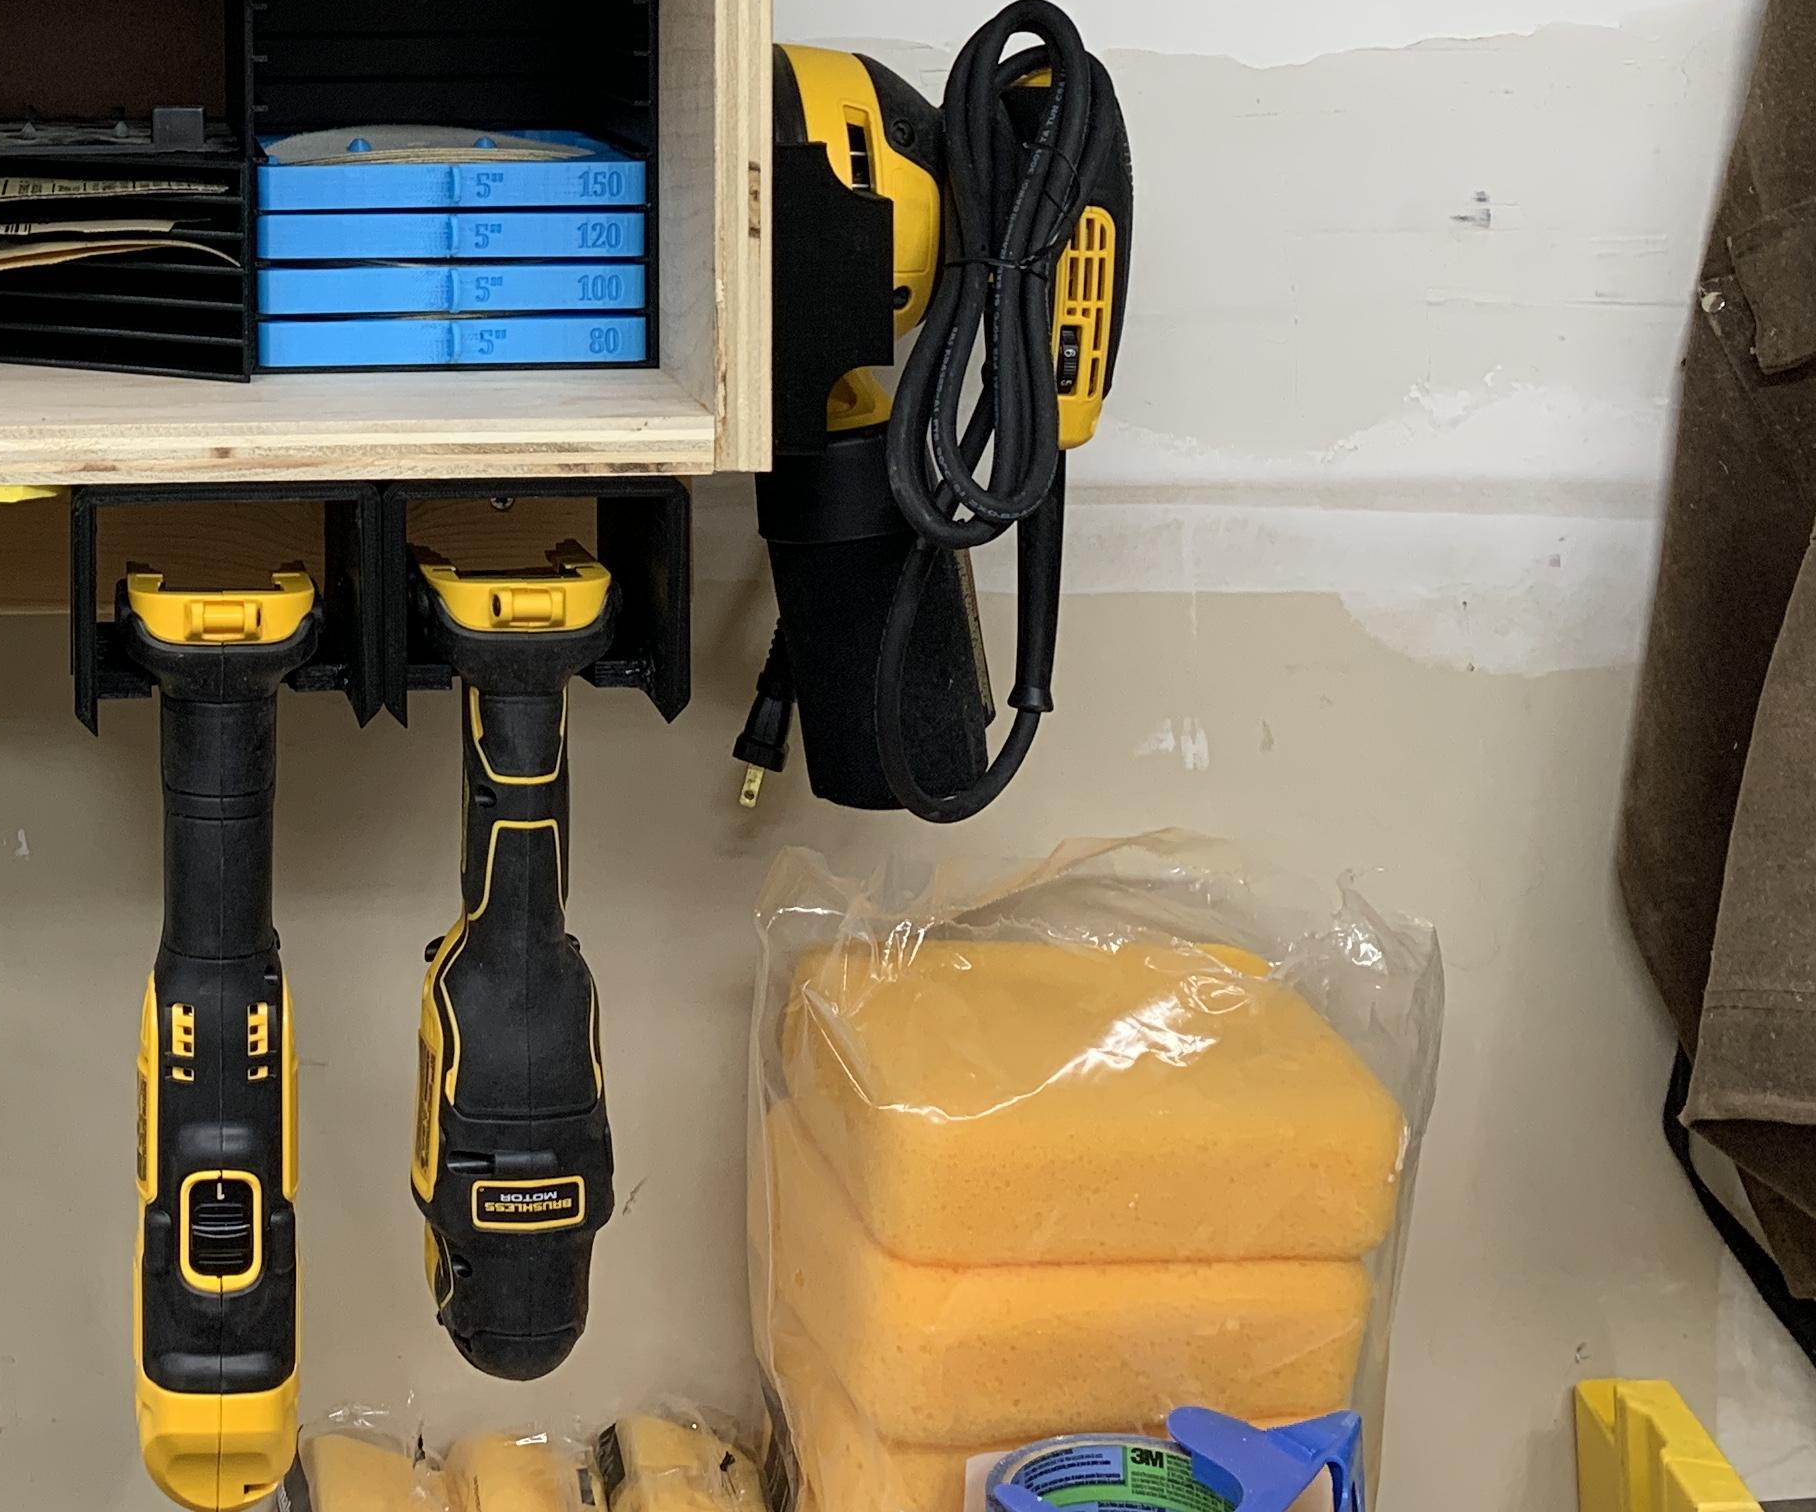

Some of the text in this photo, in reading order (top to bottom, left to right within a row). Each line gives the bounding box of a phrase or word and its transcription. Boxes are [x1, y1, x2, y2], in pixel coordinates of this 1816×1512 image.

[577, 170, 624, 198] 150
[576, 221, 623, 249] 120
[577, 274, 623, 302] 100
[589, 327, 621, 354] 80
[484, 1197, 573, 1213] BRUSHLESS
[499, 1190, 558, 1202] MOTOR
[1129, 1447, 1165, 1470] 3M
